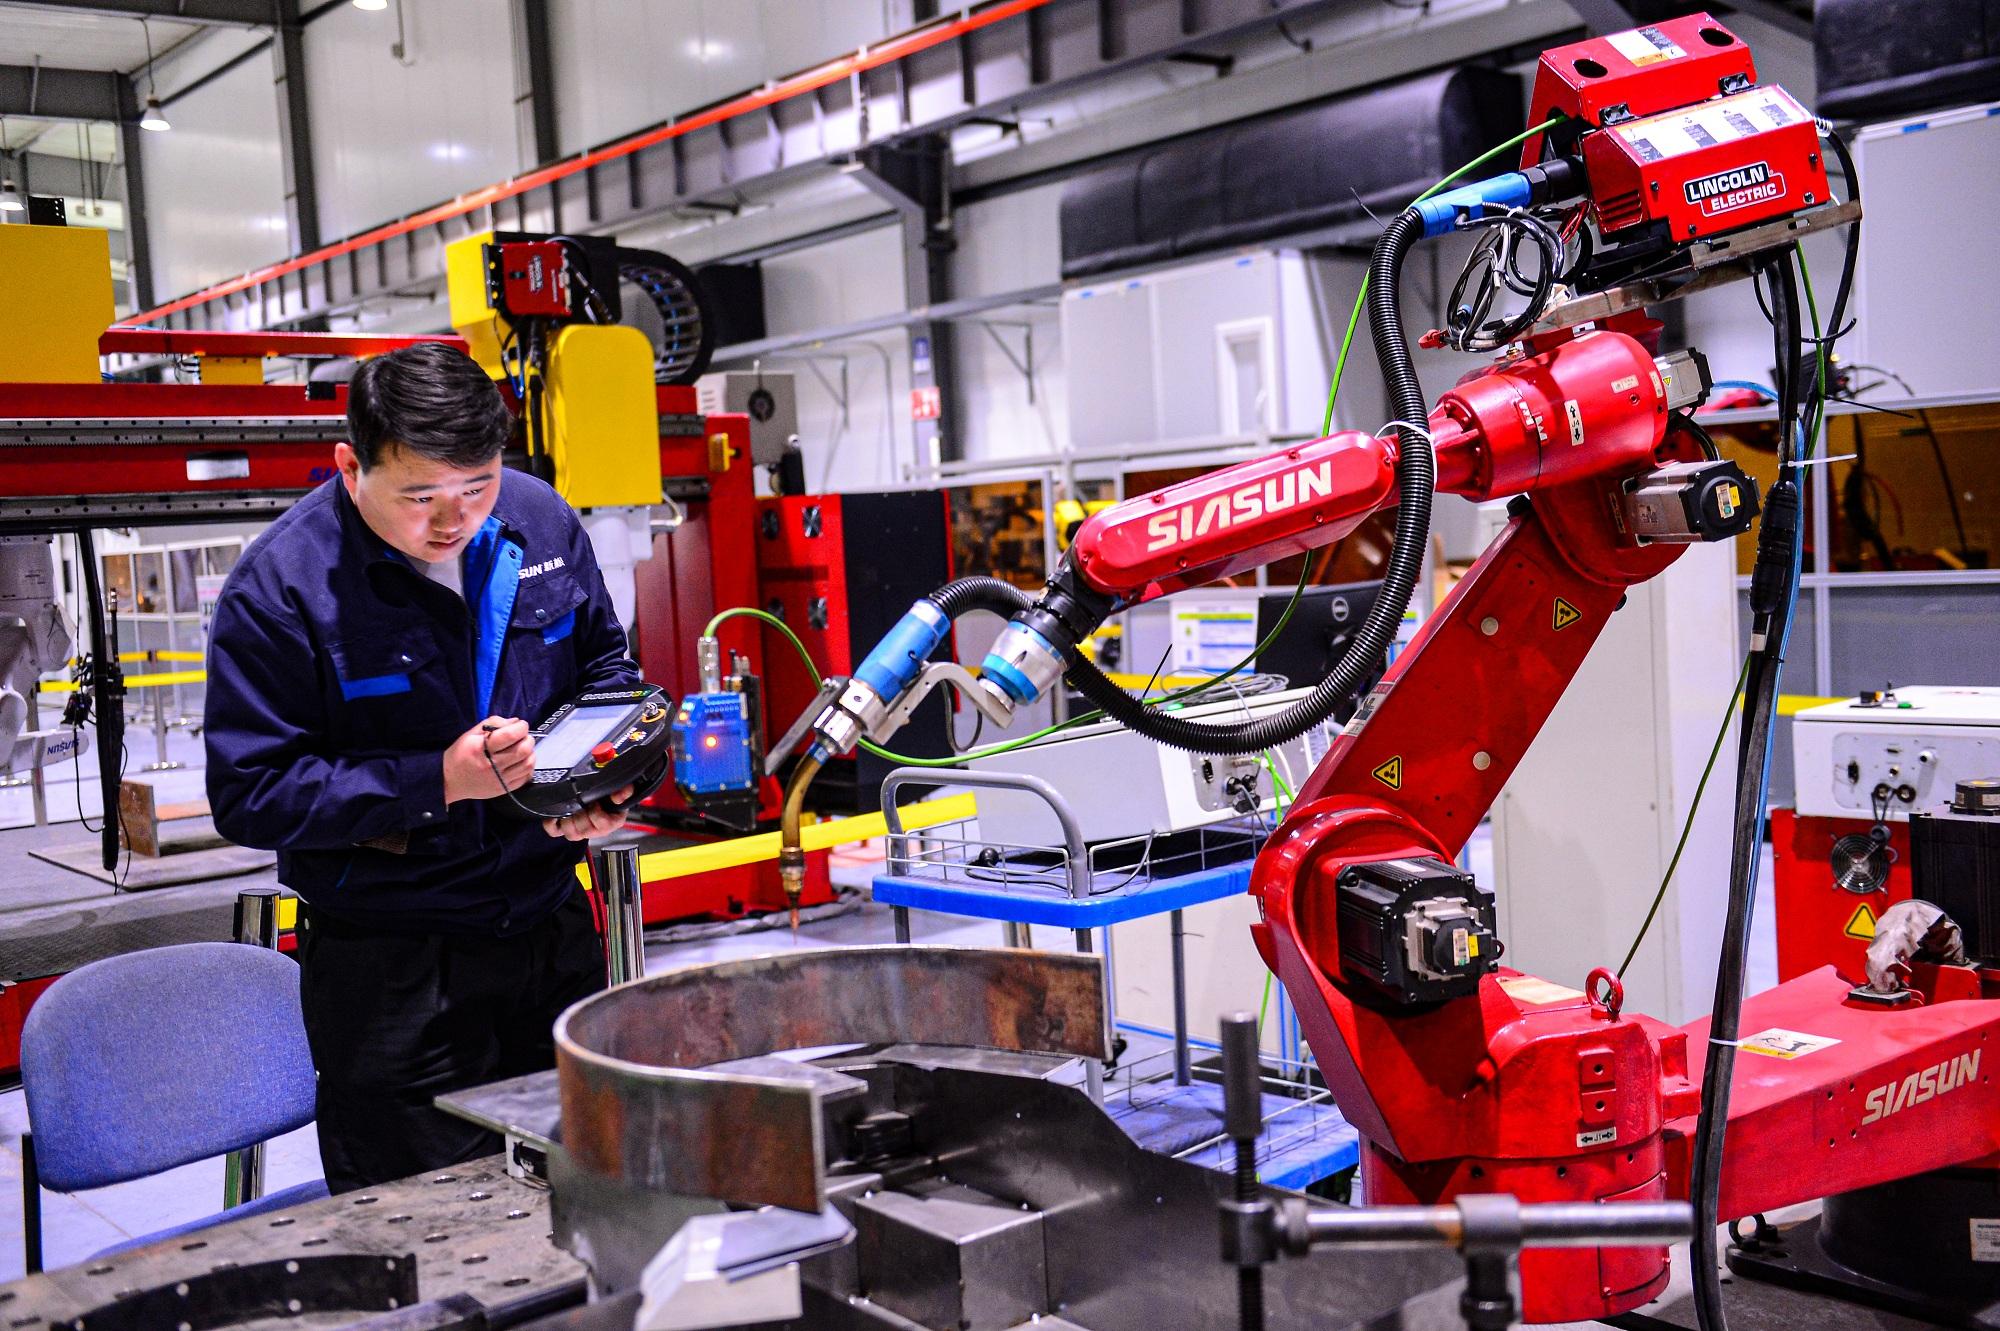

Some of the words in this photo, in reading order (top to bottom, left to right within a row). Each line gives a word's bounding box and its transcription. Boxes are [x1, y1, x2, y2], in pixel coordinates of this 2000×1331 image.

[1689, 165, 1765, 200] LINCOLN
[1710, 182, 1777, 211] ELECTRIC
[1147, 460, 1332, 552] SIASUN
[1861, 1048, 1981, 1126] SIASUN
